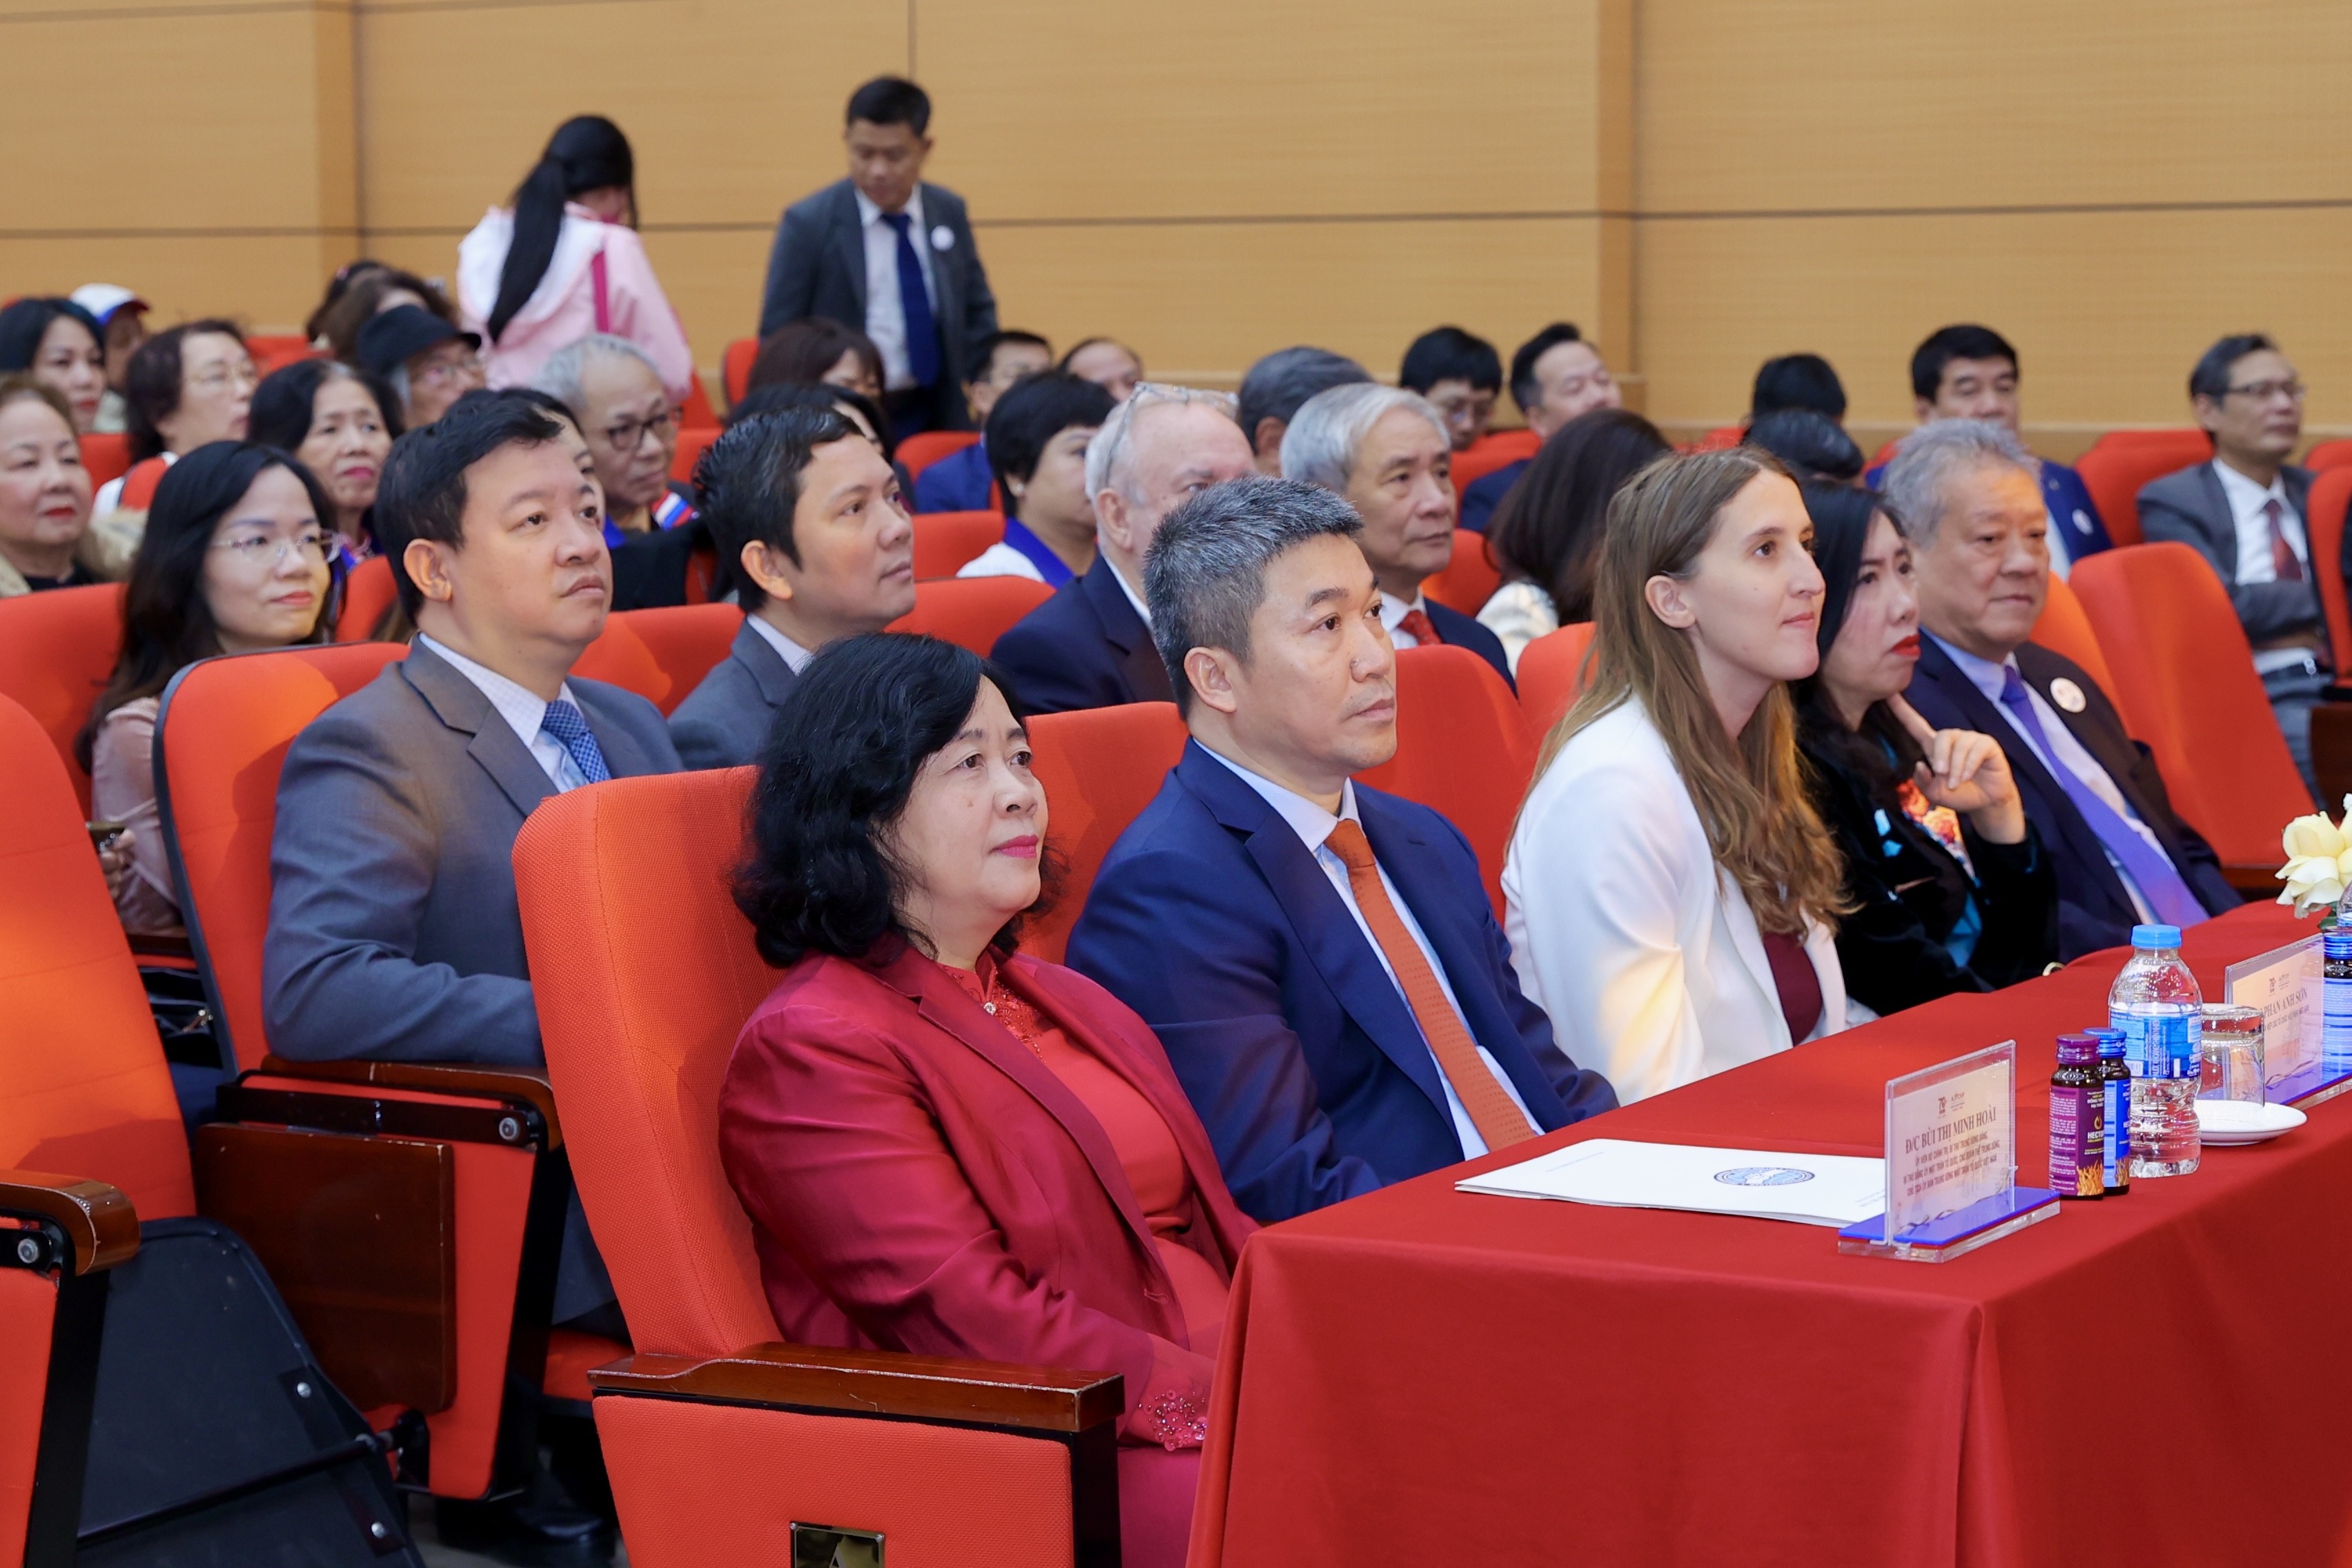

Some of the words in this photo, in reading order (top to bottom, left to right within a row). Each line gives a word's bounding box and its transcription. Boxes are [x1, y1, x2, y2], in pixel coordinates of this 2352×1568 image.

[2264, 1001, 2280, 1018] PHAN
[2282, 994, 2295, 1010] ANH
[1905, 1136, 1920, 1154] Đ/C
[1921, 1126, 1936, 1148] BÙI
[1937, 1124, 1952, 1142] THỊ
[1953, 1115, 1974, 1137] MINH
[1976, 1104, 1997, 1128] HOÀI
